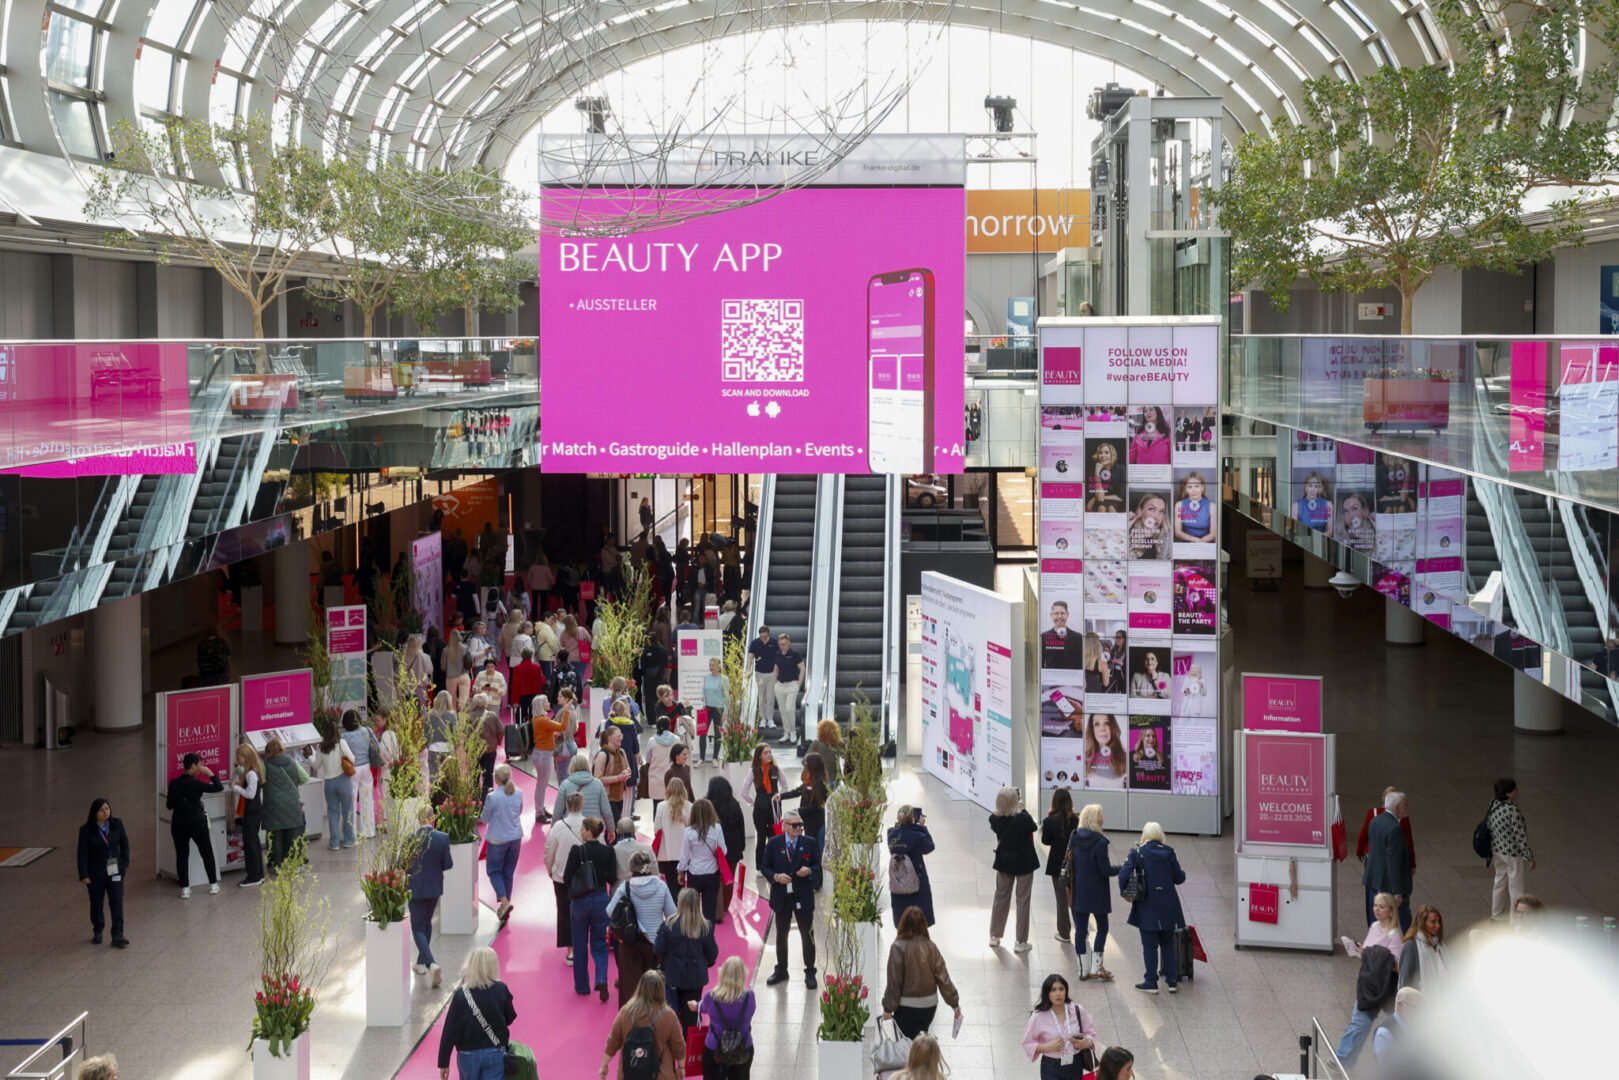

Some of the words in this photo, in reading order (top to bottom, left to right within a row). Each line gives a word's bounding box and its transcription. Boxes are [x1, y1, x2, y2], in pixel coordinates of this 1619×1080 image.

[560, 243, 699, 272] BEAUTY
[713, 243, 782, 272] APP
[577, 299, 657, 311] AUSSTELLER
[1108, 348, 1152, 357] FOLLOW
[1155, 348, 1169, 357] US
[1171, 348, 1188, 357] ON
[1108, 358, 1147, 367] SOCIAL
[1149, 358, 1187, 367] MEDIA!
[1044, 370, 1080, 379] BEAUTY
[1106, 372, 1190, 382] #weareBEAUTY
[722, 389, 743, 397] SCAN
[744, 389, 762, 397] AND
[763, 389, 810, 397] DOWNLOAD
[552, 442, 597, 456] Match
[609, 442, 699, 460] Gastroguide
[712, 442, 793, 460] Hallenplan
[805, 443, 854, 456] Events
[1269, 698, 1295, 707] BEAUTY
[260, 711, 294, 721] Information
[1263, 714, 1301, 723] Information
[178, 724, 218, 738] BEAUTY
[176, 748, 220, 762] WOME
[1175, 770, 1203, 780] FAQ'S
[1261, 774, 1310, 787] BEAUTY
[1259, 802, 1313, 814] WELCOME
[1251, 904, 1275, 914] BEAUTY
